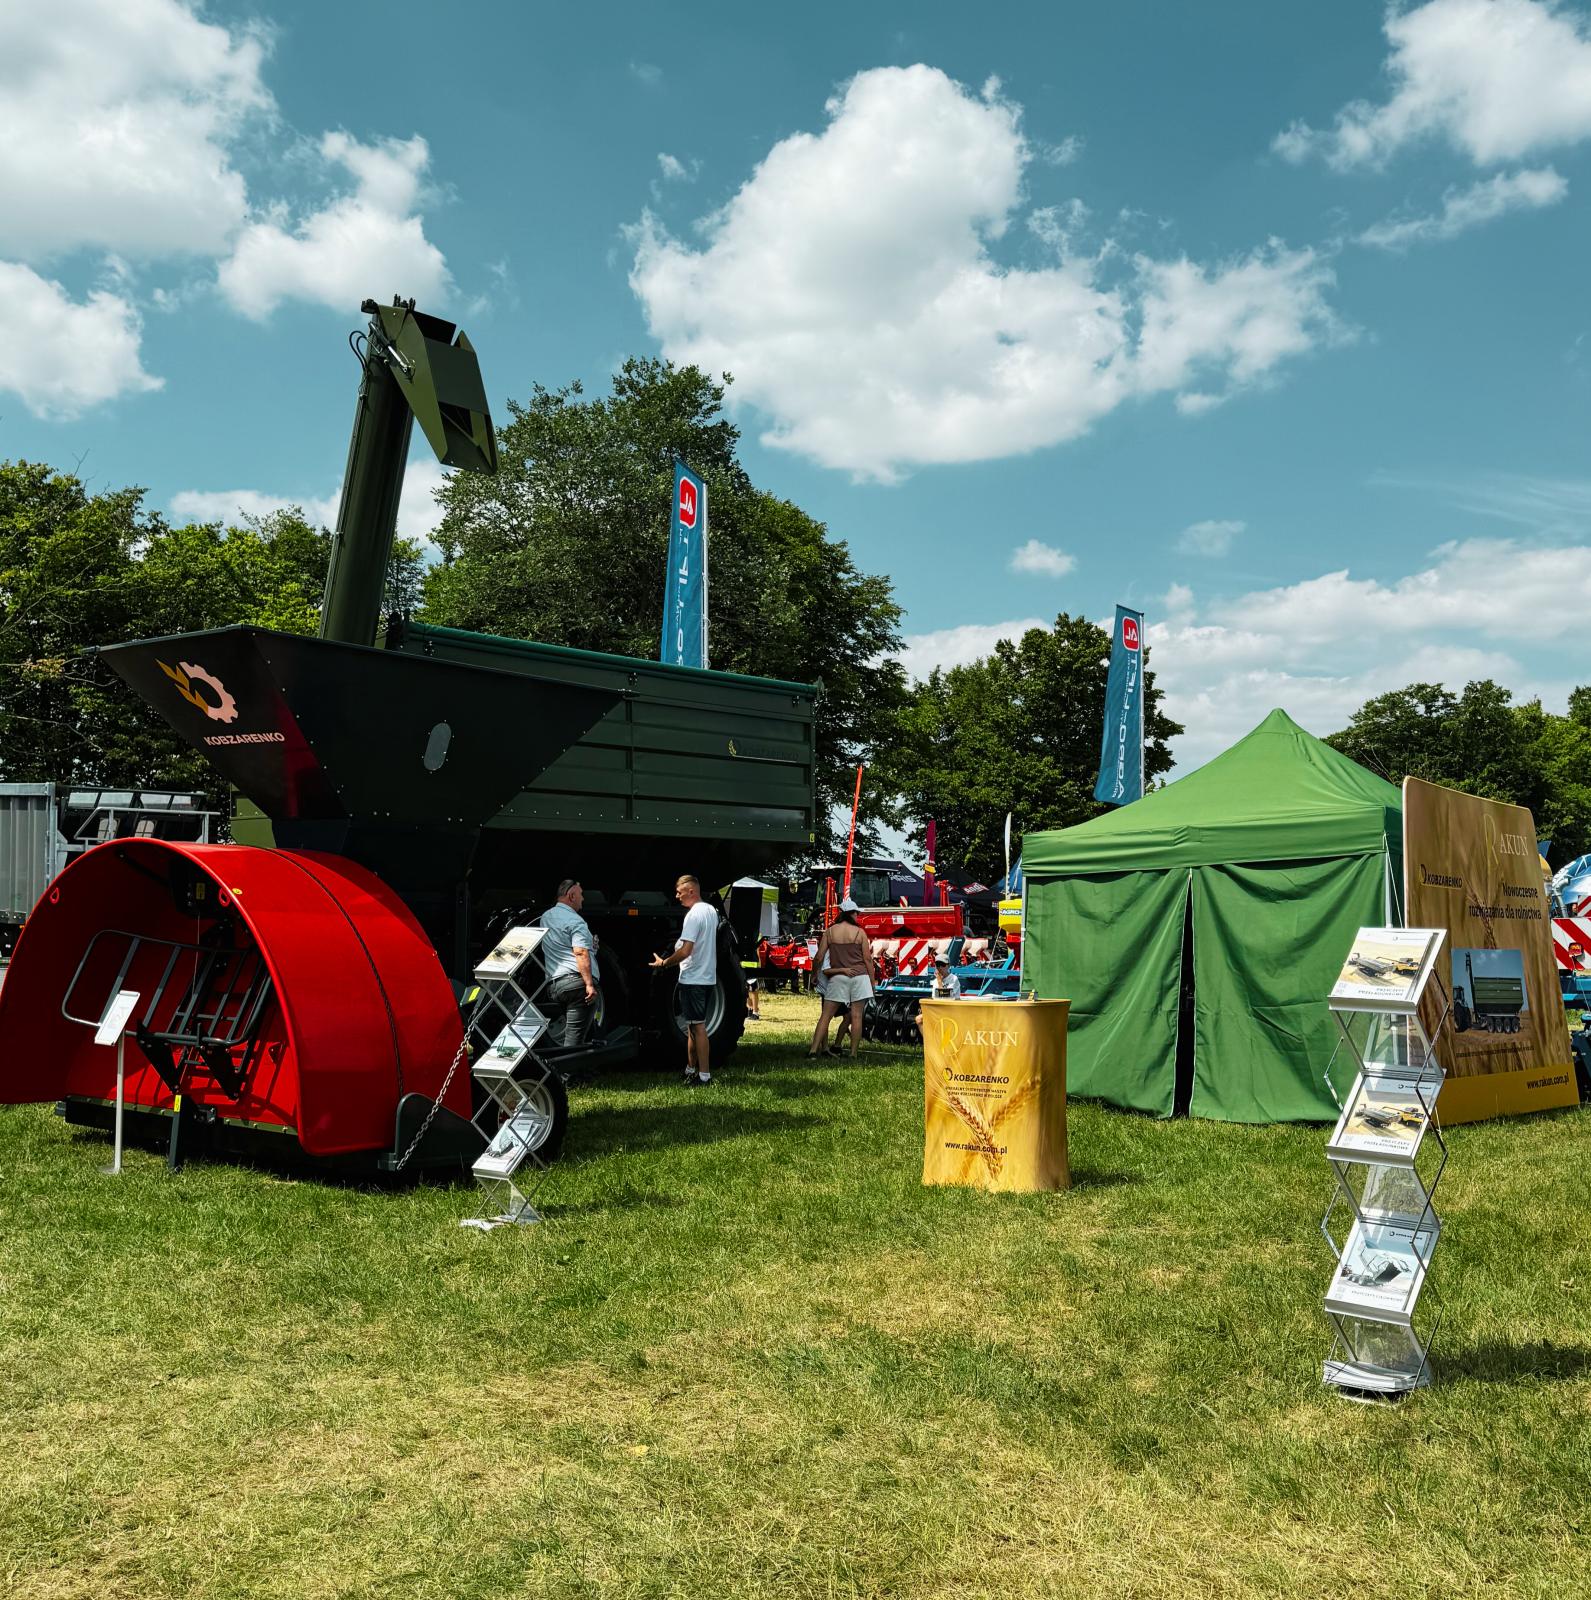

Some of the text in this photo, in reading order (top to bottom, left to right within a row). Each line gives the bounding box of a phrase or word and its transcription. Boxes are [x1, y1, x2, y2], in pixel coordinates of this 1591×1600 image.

[203, 732, 286, 746] KOBZARENKO
[1427, 872, 1463, 889] KOBZARENKO
[1502, 883, 1539, 898] Nowoczesne
[1505, 904, 1515, 919] dla
[1515, 905, 1542, 920] rolnictwa
[940, 1017, 1019, 1054] RAKUN
[953, 1074, 1010, 1084] KOBZARENKO
[1526, 1072, 1570, 1089] www.rakun.com.pl
[945, 1142, 1008, 1155] www.rakun.com.pl
